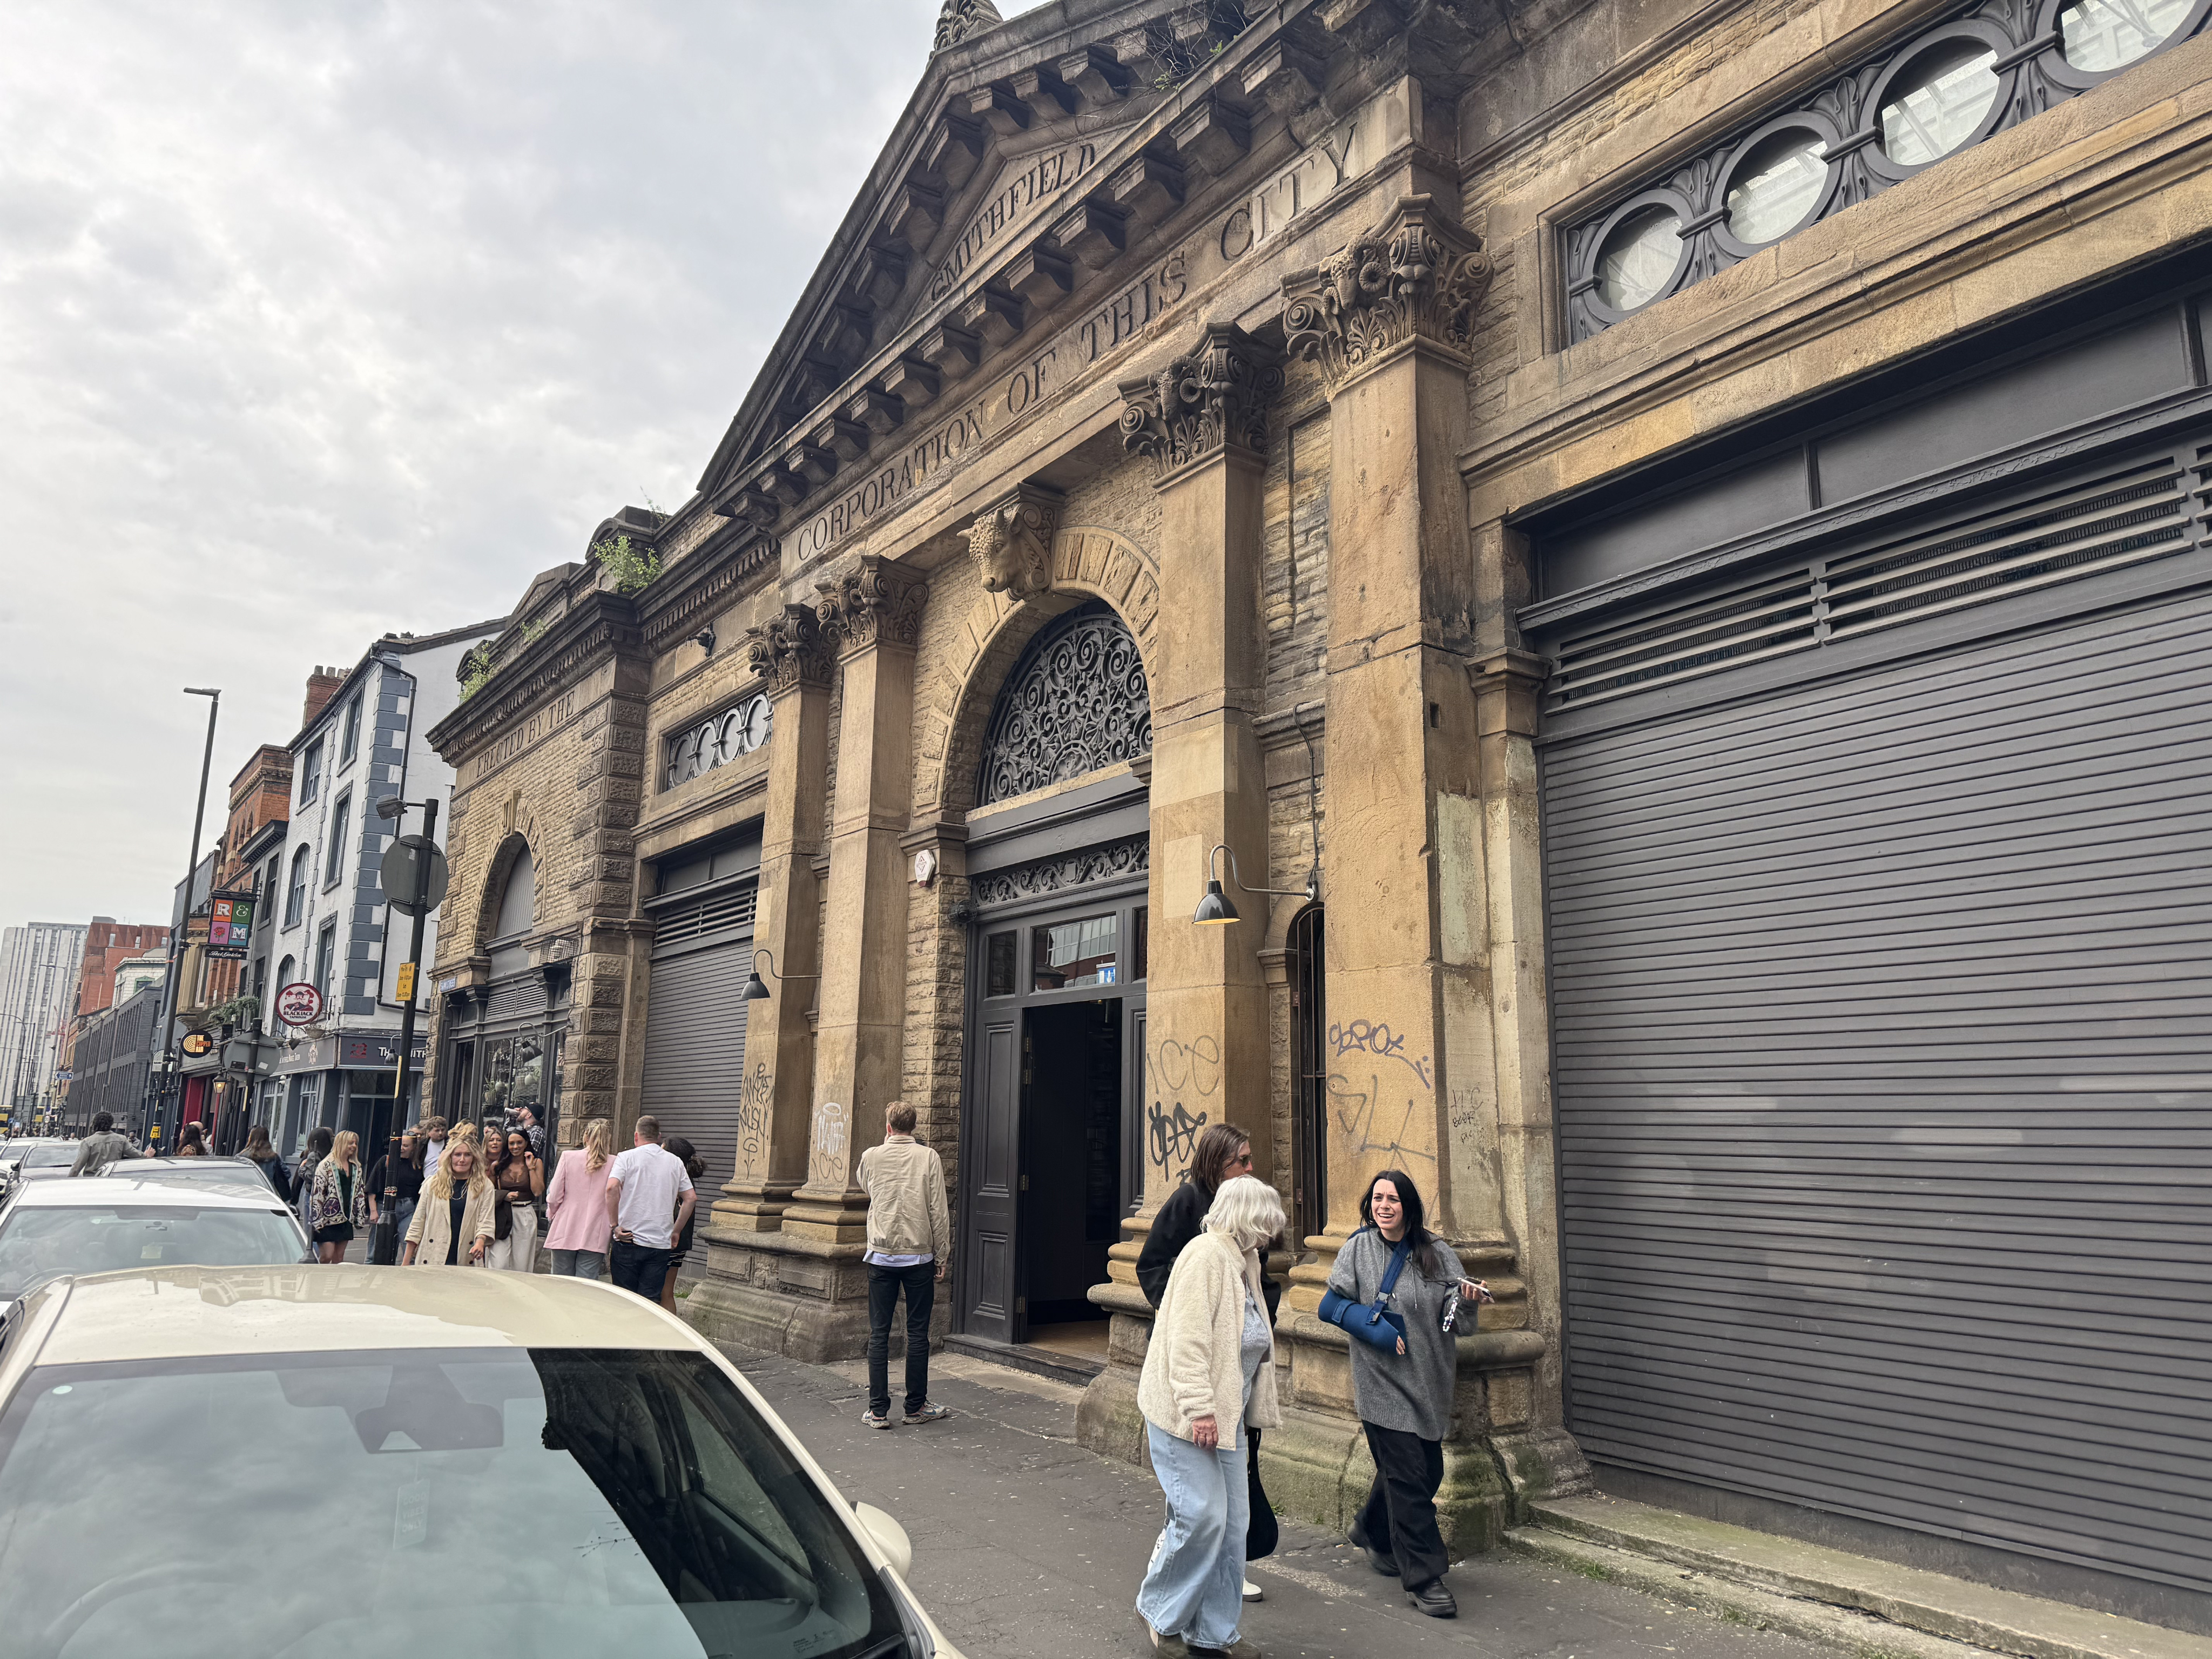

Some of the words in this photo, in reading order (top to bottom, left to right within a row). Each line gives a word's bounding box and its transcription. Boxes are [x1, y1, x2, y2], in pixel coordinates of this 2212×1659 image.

[930, 143, 1095, 301] SMITHFIELD
[798, 398, 987, 562] CORPORATION
[1007, 347, 1056, 414] OF
[1081, 250, 1186, 362] THIS
[1220, 121, 1358, 261] CITY
[475, 727, 524, 778] ERECTED
[527, 711, 544, 744] BY
[548, 690, 575, 730] THE
[214, 902, 231, 917] R
[235, 905, 249, 916] &
[230, 927, 247, 941] M
